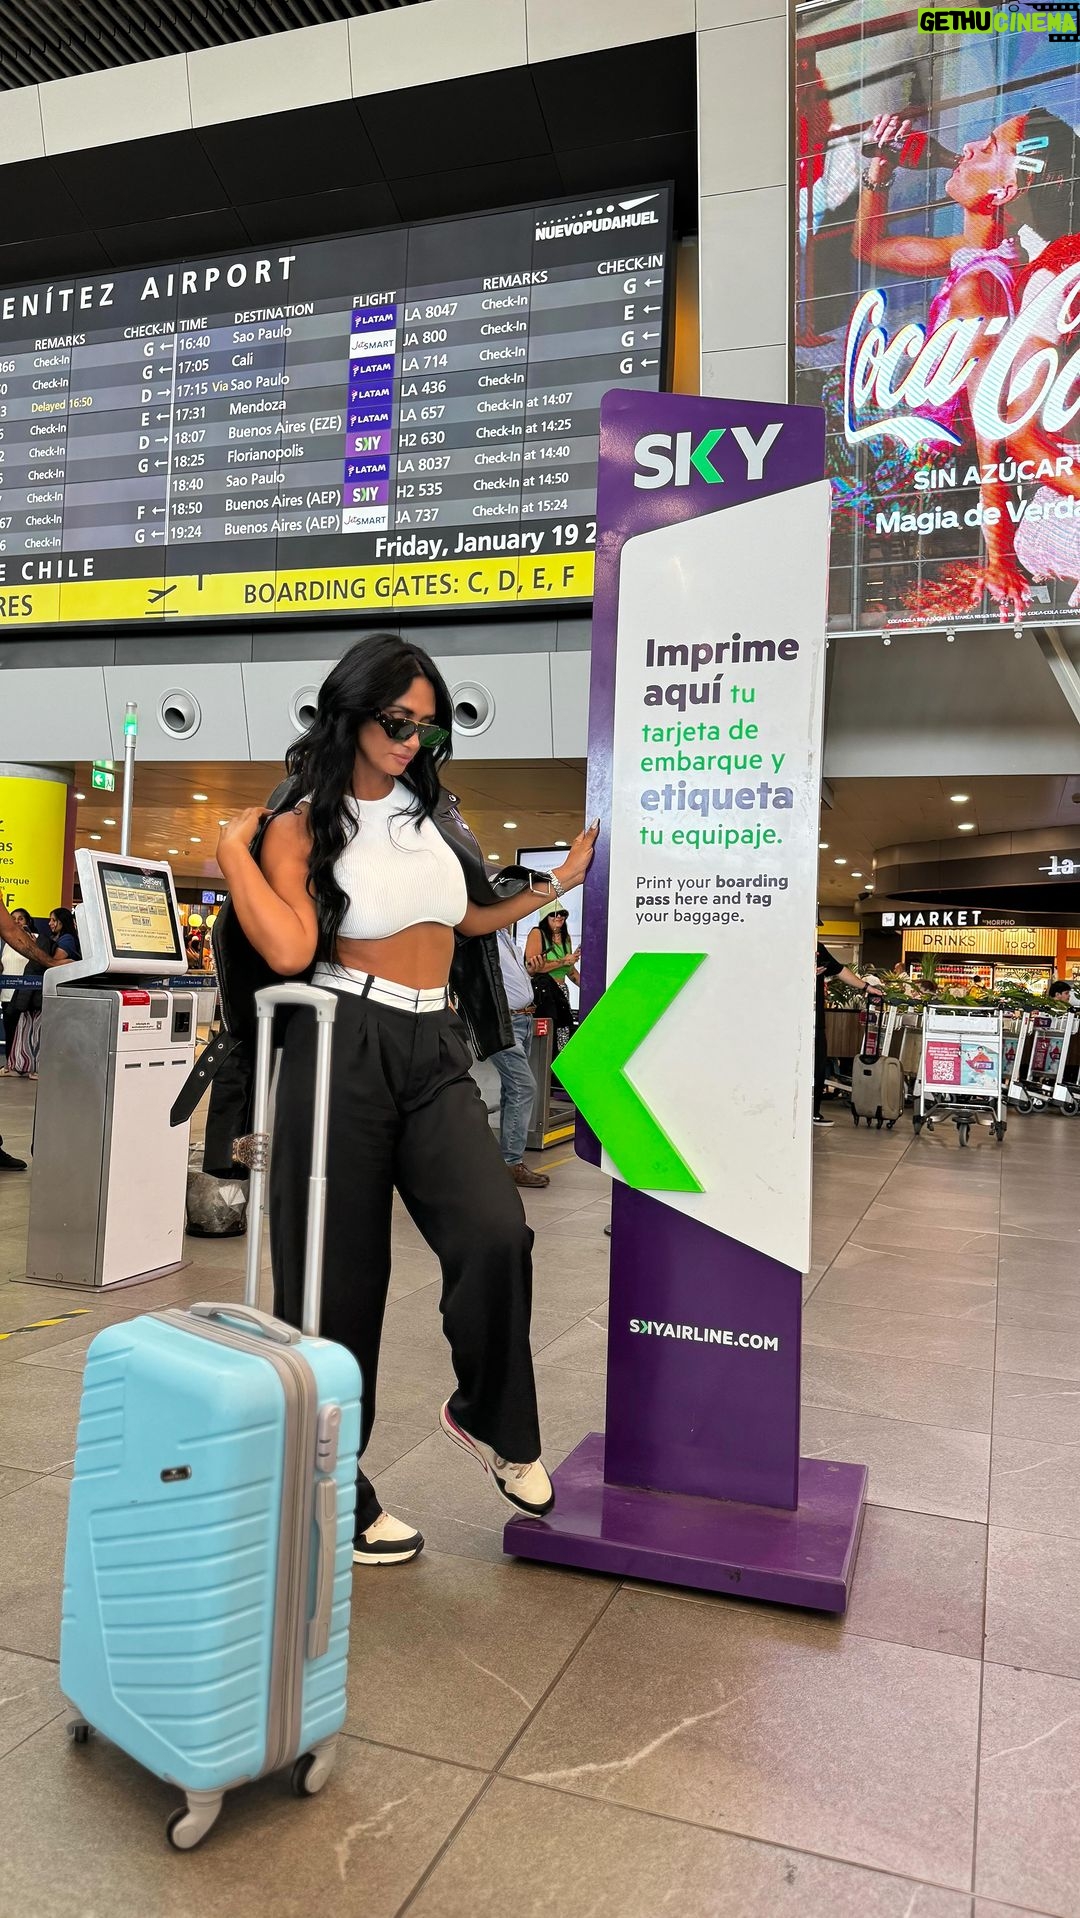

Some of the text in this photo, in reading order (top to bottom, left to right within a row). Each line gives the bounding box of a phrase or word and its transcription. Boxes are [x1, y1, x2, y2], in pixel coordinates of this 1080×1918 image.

[535, 211, 659, 241] NUEVOPUDAHUEL
[141, 255, 295, 300] AIRPORT
[180, 254, 663, 331] TIME DESTINATION FLIGHT REMARKS CHECK-IN
[179, 278, 637, 350] 16:40 Sao Paulo LATAM LA 8047 Check-In G
[35, 322, 174, 350] REMARKS CHECK-IN
[178, 359, 209, 373] 17:05
[232, 353, 254, 367] Cali
[403, 334, 418, 347] JA
[423, 329, 447, 343] 800
[480, 321, 527, 336] Check-In
[624, 305, 635, 321] E
[33, 342, 154, 368] Check-In G
[177, 331, 634, 397] 17:15 Via Sao Paulo LATAM LA 714 Check-In G
[32, 365, 153, 390] Check-In G
[176, 357, 633, 421] 17:31 Mendoza LATAM LA 436 Check-In G
[32, 389, 152, 413] Delayed 16:50 D
[30, 412, 150, 436] Check-In E
[175, 392, 573, 444] 18:07 Buenos Aires (EZE) LATAM LA 657 Check-In at 14:07
[29, 436, 150, 458] Check-In D
[174, 454, 204, 468] 18:25
[228, 444, 304, 463] Florianopolis
[399, 434, 417, 447] H2
[421, 431, 445, 445] 630
[476, 425, 522, 438] Check-In
[525, 423, 537, 434] at
[541, 419, 571, 432] 14:25
[634, 423, 784, 490] SKY
[28, 459, 148, 481] Check-In G
[173, 446, 570, 492] 18:40 Sao Paulo LATAM LA 8037 Check-In at 14:40
[913, 456, 1074, 490] SIN AZÚCAR
[27, 492, 63, 503] Check-In
[172, 502, 202, 515] 18:50
[225, 499, 268, 512] Buenos
[272, 494, 303, 508] Aires
[307, 490, 341, 507] (AEP)
[397, 485, 414, 498] H2
[419, 482, 442, 497] 535
[473, 477, 519, 491] Check-In
[523, 476, 535, 487] at
[539, 472, 569, 485] 14:50
[25, 514, 62, 526] Check-In
[137, 506, 145, 520] F
[171, 526, 202, 539] 19:24
[225, 523, 268, 535] Buenos
[271, 519, 302, 532] Aires
[306, 515, 340, 532] (AEP)
[395, 511, 411, 524] JA
[415, 508, 439, 522] 737
[472, 504, 518, 517] Check-In
[522, 502, 534, 512] at
[538, 499, 568, 511] 15:24
[876, 506, 960, 535] Magia
[964, 502, 1000, 526] de
[25, 529, 145, 549] Check-In G
[375, 537, 448, 560] Friday,
[454, 528, 544, 554] January
[551, 523, 579, 546] 19
[22, 558, 94, 580] CHILE
[244, 566, 575, 604] BOARDING GATES: C, D, E, F
[646, 632, 799, 672] Imprime
[643, 673, 755, 712] aquí tu
[642, 718, 758, 747] tarjeta de
[641, 750, 785, 775] embarque y
[640, 780, 793, 817] etiqueta
[640, 823, 783, 849] tu equipaje.
[636, 874, 788, 891] Print your boarding
[6, 894, 15, 907] F
[636, 891, 772, 908] pass here and tag
[636, 909, 745, 925] your baggage.
[900, 910, 981, 926] MARKET
[923, 935, 976, 946] DRINKS
[1006, 941, 1036, 949] TO GO
[629, 1319, 778, 1351] SKYAIRLINE.COM
